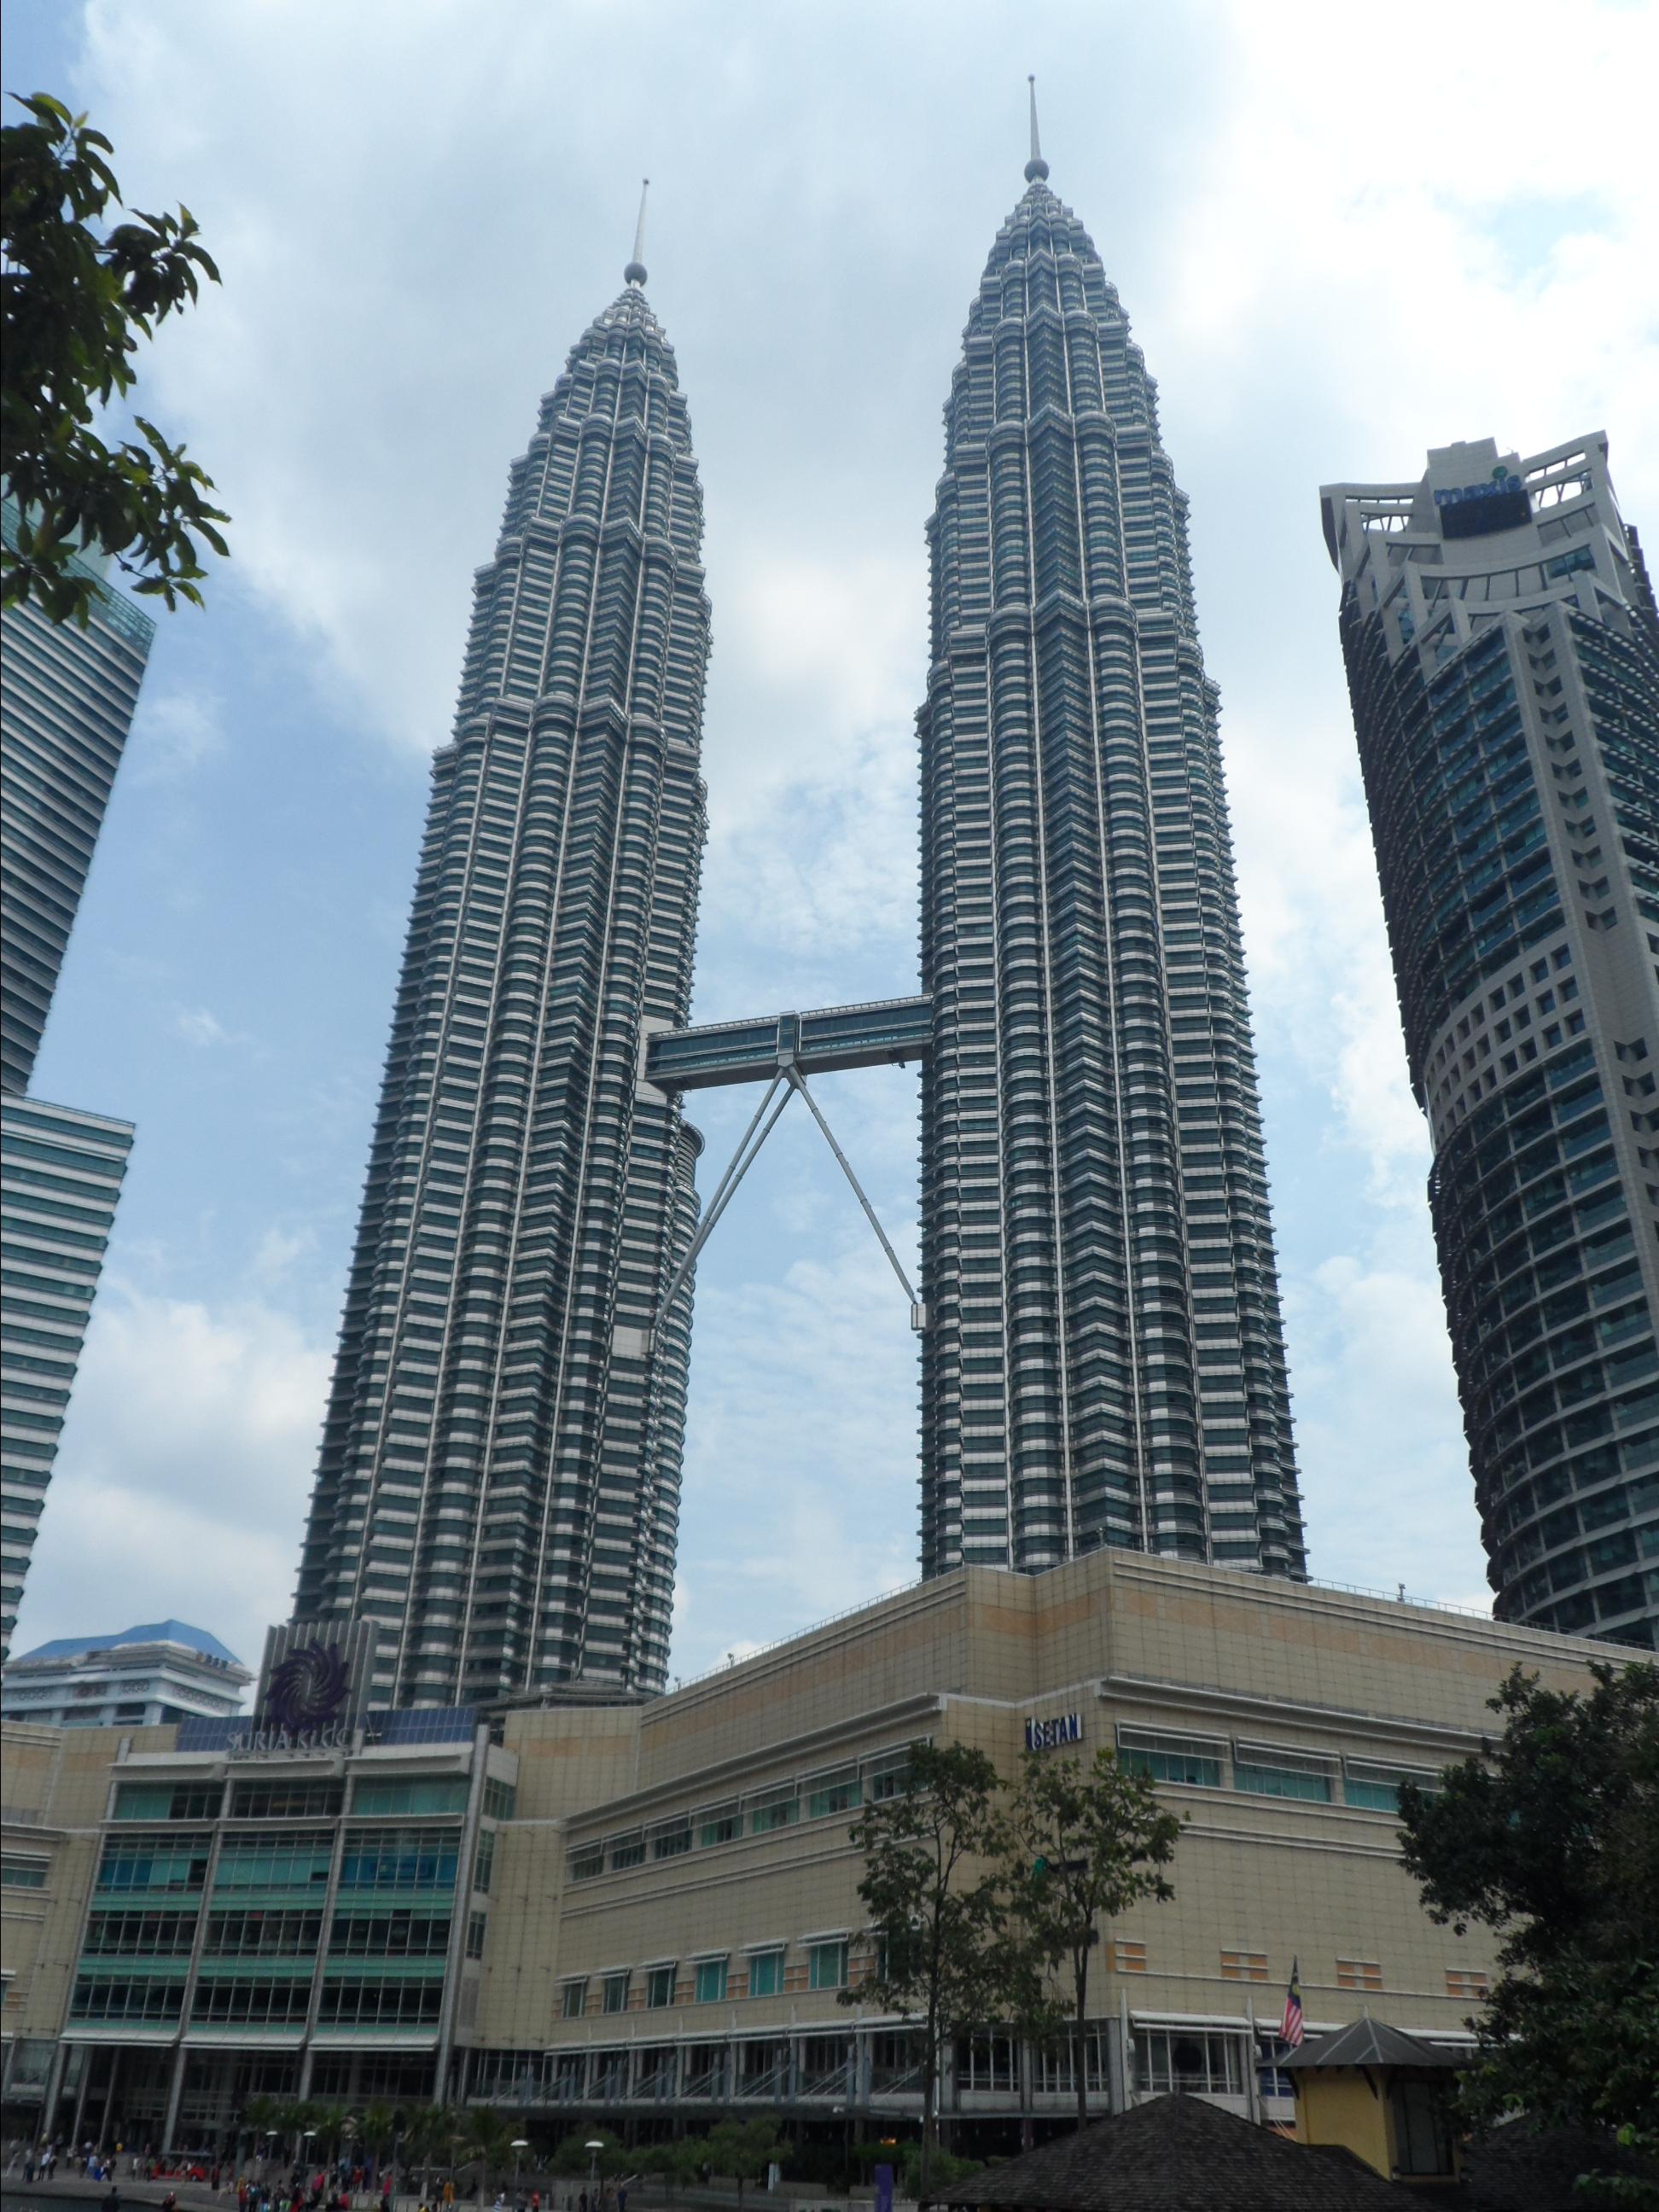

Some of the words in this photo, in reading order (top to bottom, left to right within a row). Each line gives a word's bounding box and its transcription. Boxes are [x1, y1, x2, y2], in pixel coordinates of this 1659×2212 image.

[1434, 466, 1522, 505] maxis
[226, 1728, 291, 1751] SURIA
[297, 1727, 350, 1749] KLCC
